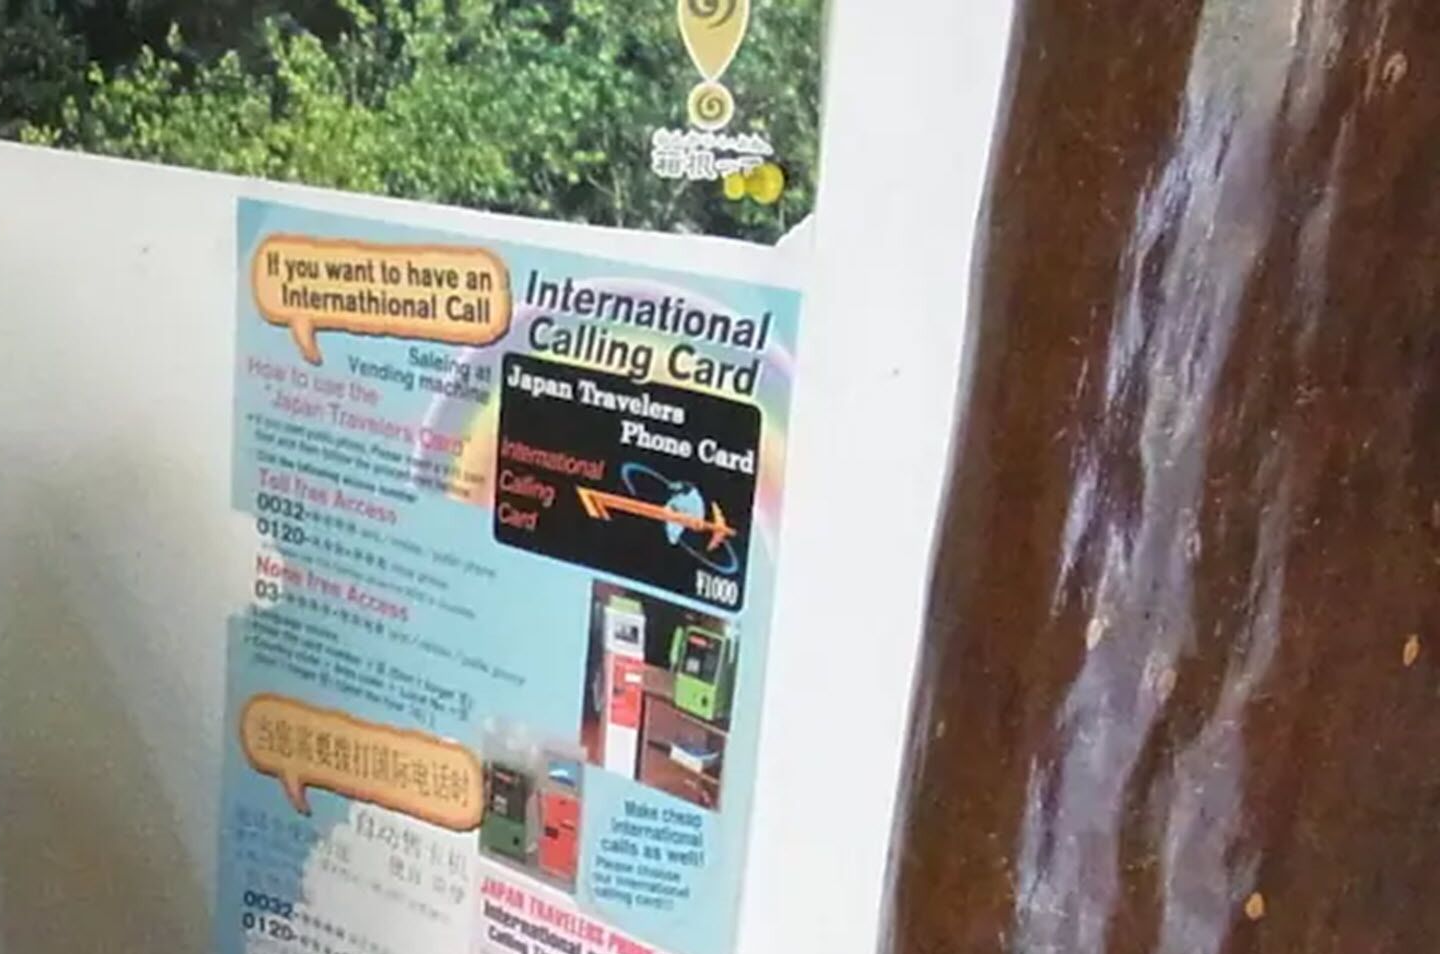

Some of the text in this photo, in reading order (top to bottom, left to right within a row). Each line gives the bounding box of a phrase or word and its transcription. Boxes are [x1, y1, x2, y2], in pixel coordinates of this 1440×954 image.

[267, 252, 492, 292] If you want to have an
[445, 296, 490, 325] Call
[526, 269, 774, 351] International
[347, 355, 415, 391] Vending
[529, 315, 760, 397] Calling Card
[291, 365, 309, 387] to
[507, 364, 686, 426] Japan Travelers
[502, 439, 606, 481] International
[620, 420, 755, 475] Phone Card
[499, 469, 556, 507] Calling
[497, 503, 539, 531] Card
[481, 877, 524, 908] JAPAN
